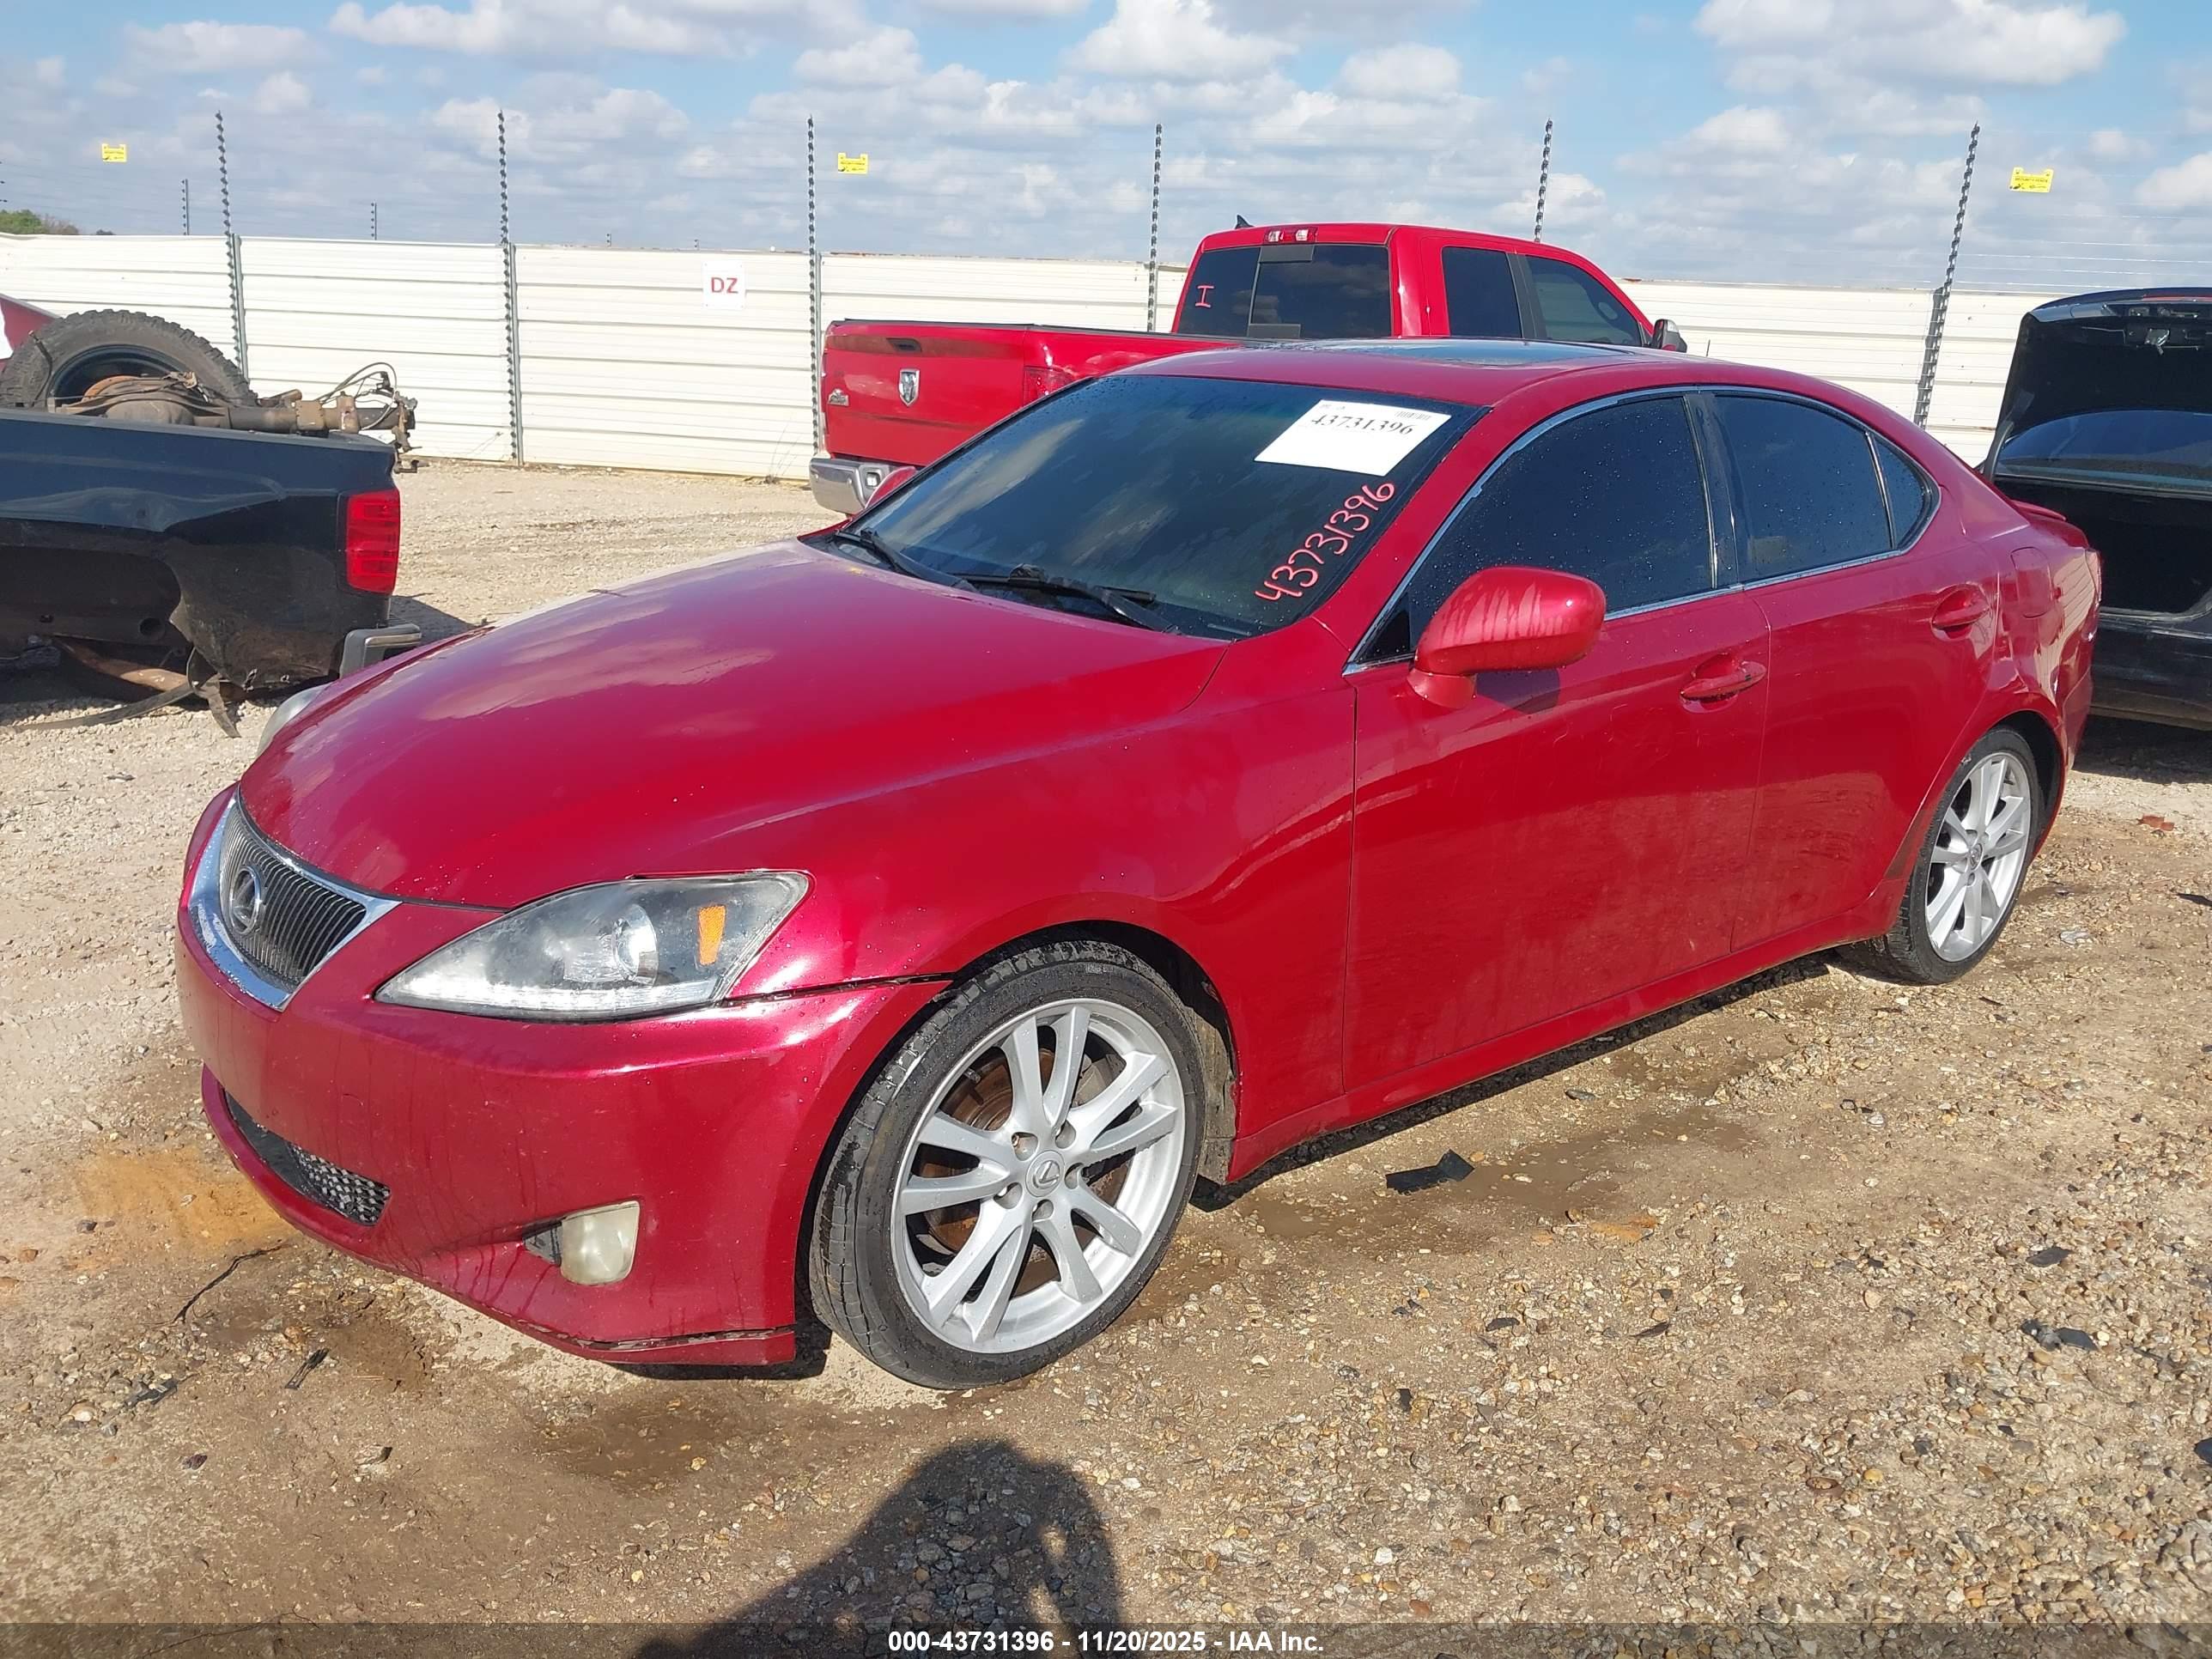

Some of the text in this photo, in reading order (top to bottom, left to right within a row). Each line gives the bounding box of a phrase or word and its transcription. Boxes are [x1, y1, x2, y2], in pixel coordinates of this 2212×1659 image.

[711, 276, 738, 295] DZ
[1194, 285, 1214, 307] I
[1311, 414, 1415, 435] 43731396
[1255, 483, 1395, 601] 43731396
